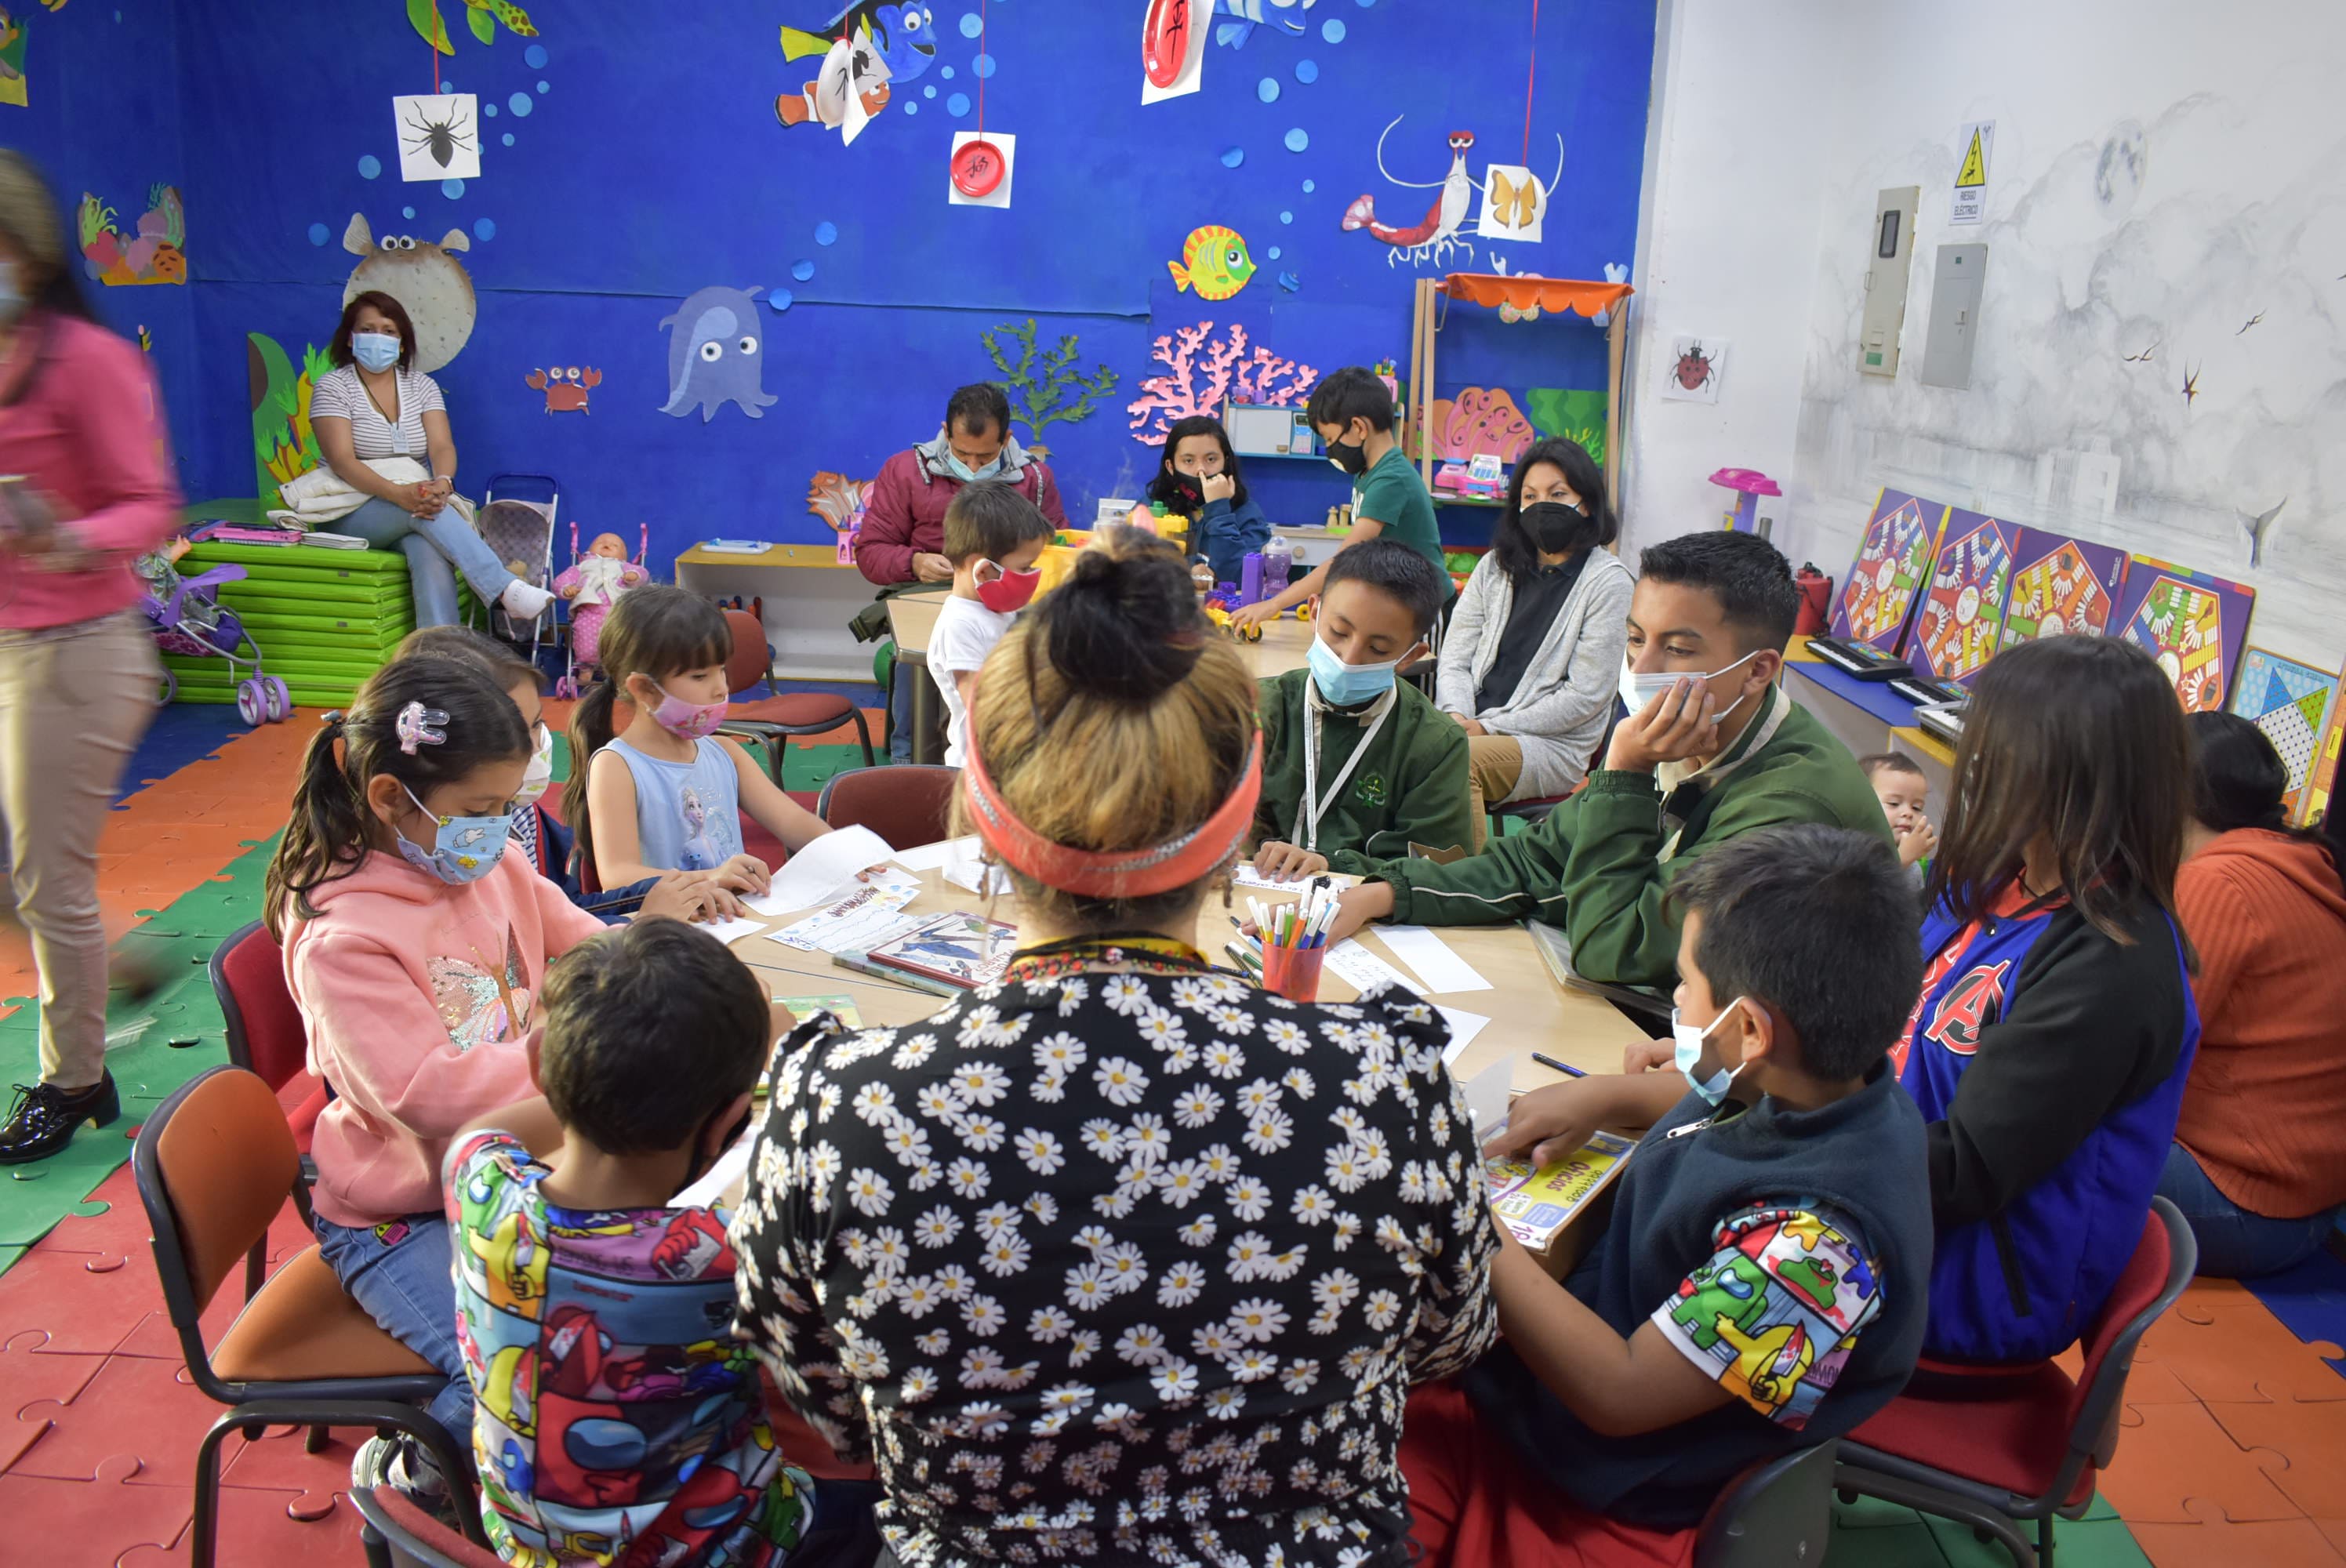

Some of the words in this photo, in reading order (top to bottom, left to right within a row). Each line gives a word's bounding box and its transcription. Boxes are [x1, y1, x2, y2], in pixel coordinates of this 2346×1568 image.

[1960, 190, 1977, 201] RIESGO
[1954, 203, 1979, 216] ELÉCTRICO
[1545, 1160, 1591, 1192] Oficios
